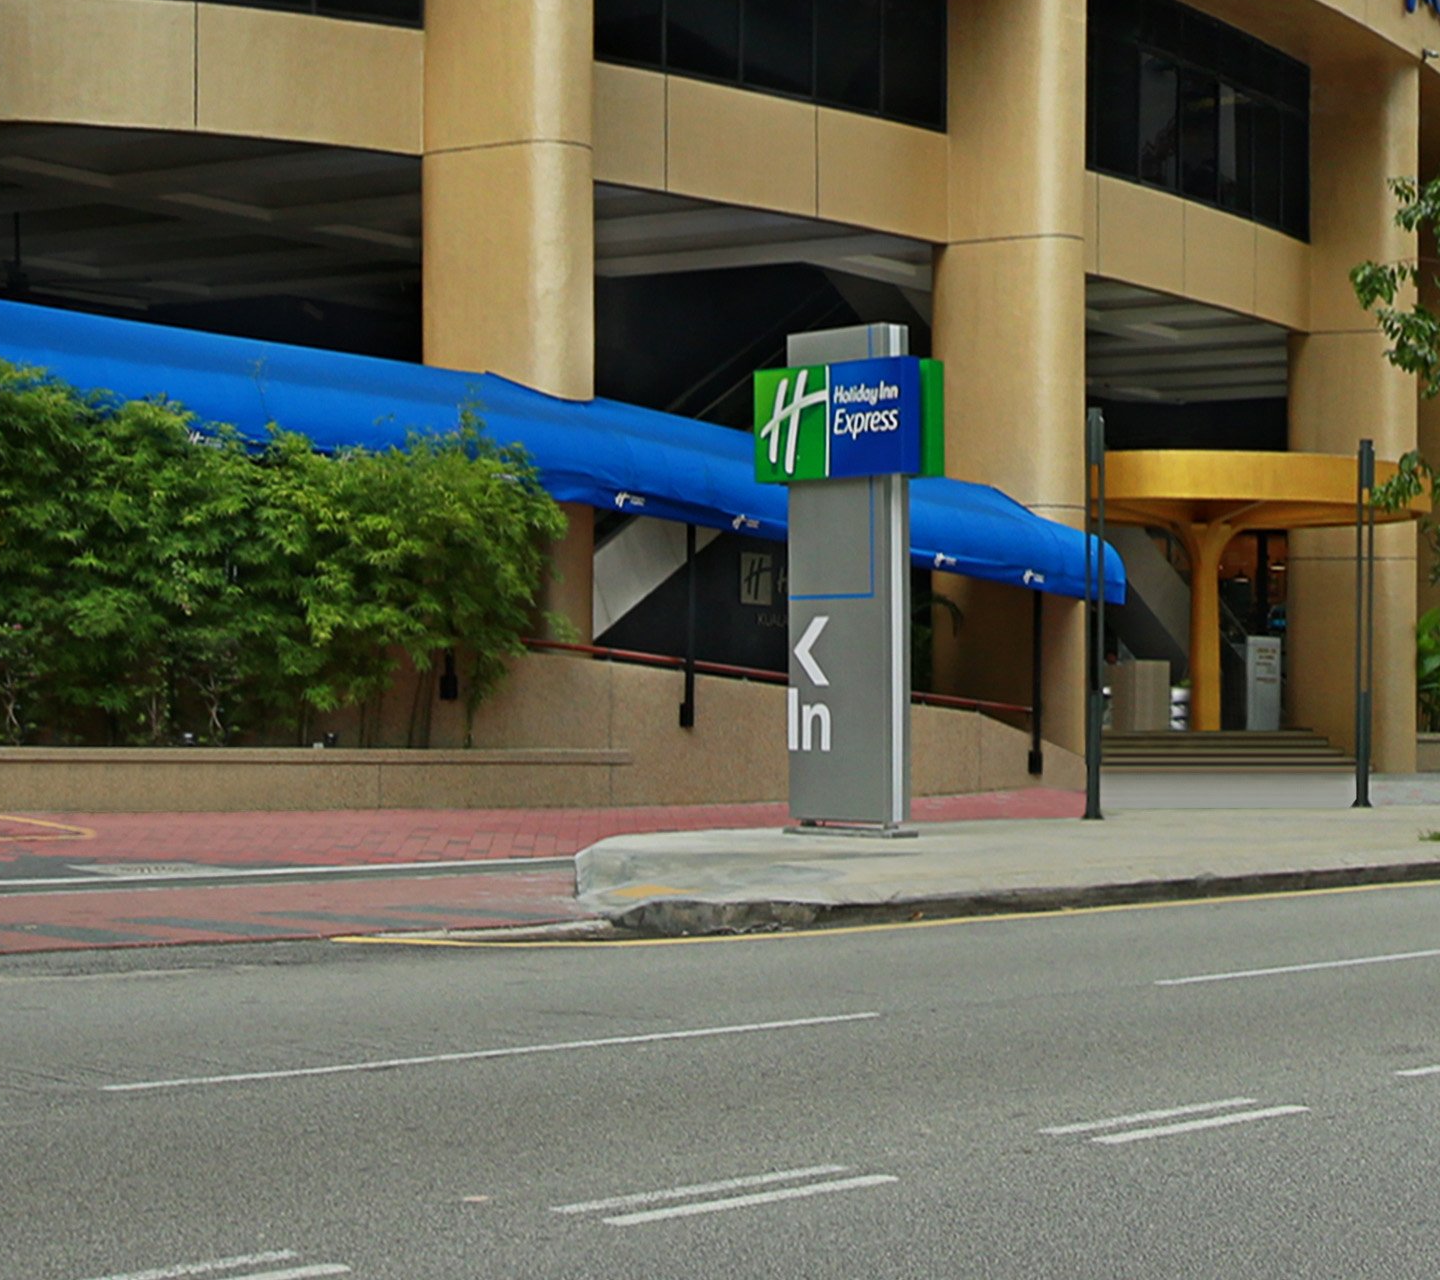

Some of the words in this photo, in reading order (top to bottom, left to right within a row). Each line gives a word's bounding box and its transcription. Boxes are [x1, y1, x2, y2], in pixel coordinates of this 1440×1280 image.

[833, 383, 878, 406] Holiday
[879, 381, 899, 399] Inn
[833, 408, 899, 440] Express
[788, 687, 831, 752] In
